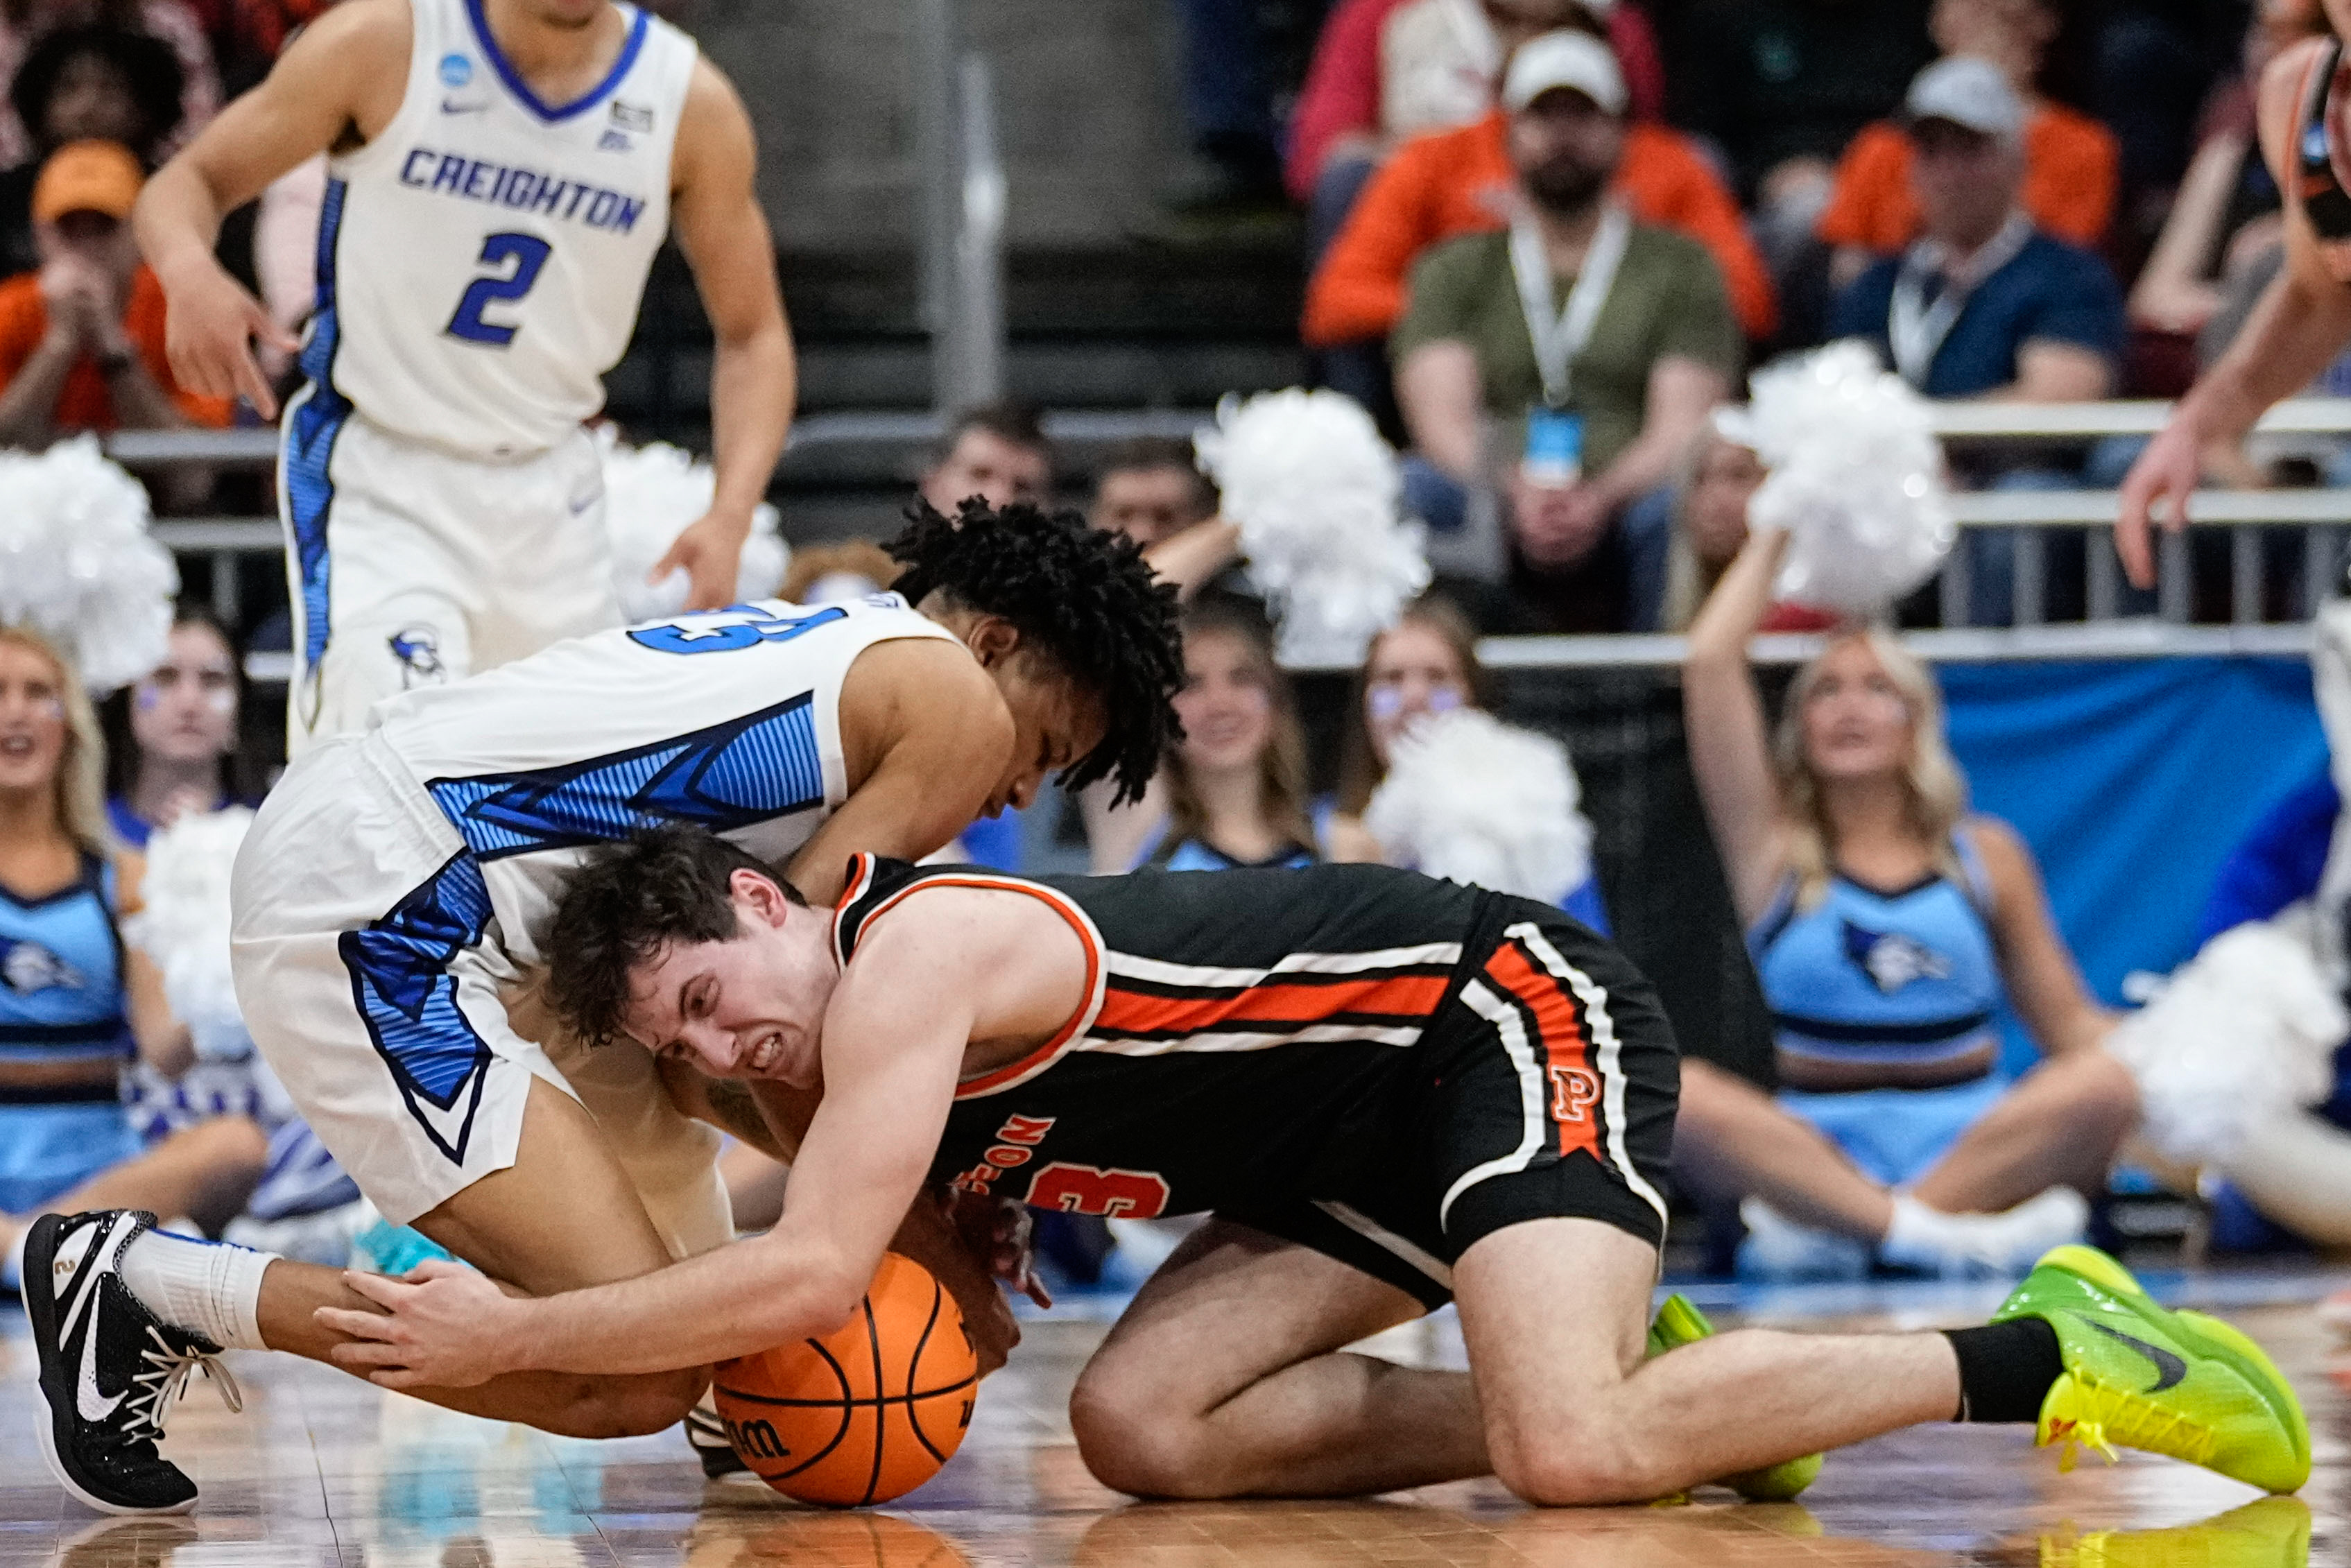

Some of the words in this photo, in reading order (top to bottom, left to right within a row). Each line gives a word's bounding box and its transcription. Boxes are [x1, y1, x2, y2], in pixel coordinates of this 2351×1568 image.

[399, 148, 646, 234] CREIGHTON
[444, 231, 553, 348] 2
[1551, 1065, 1600, 1121] P
